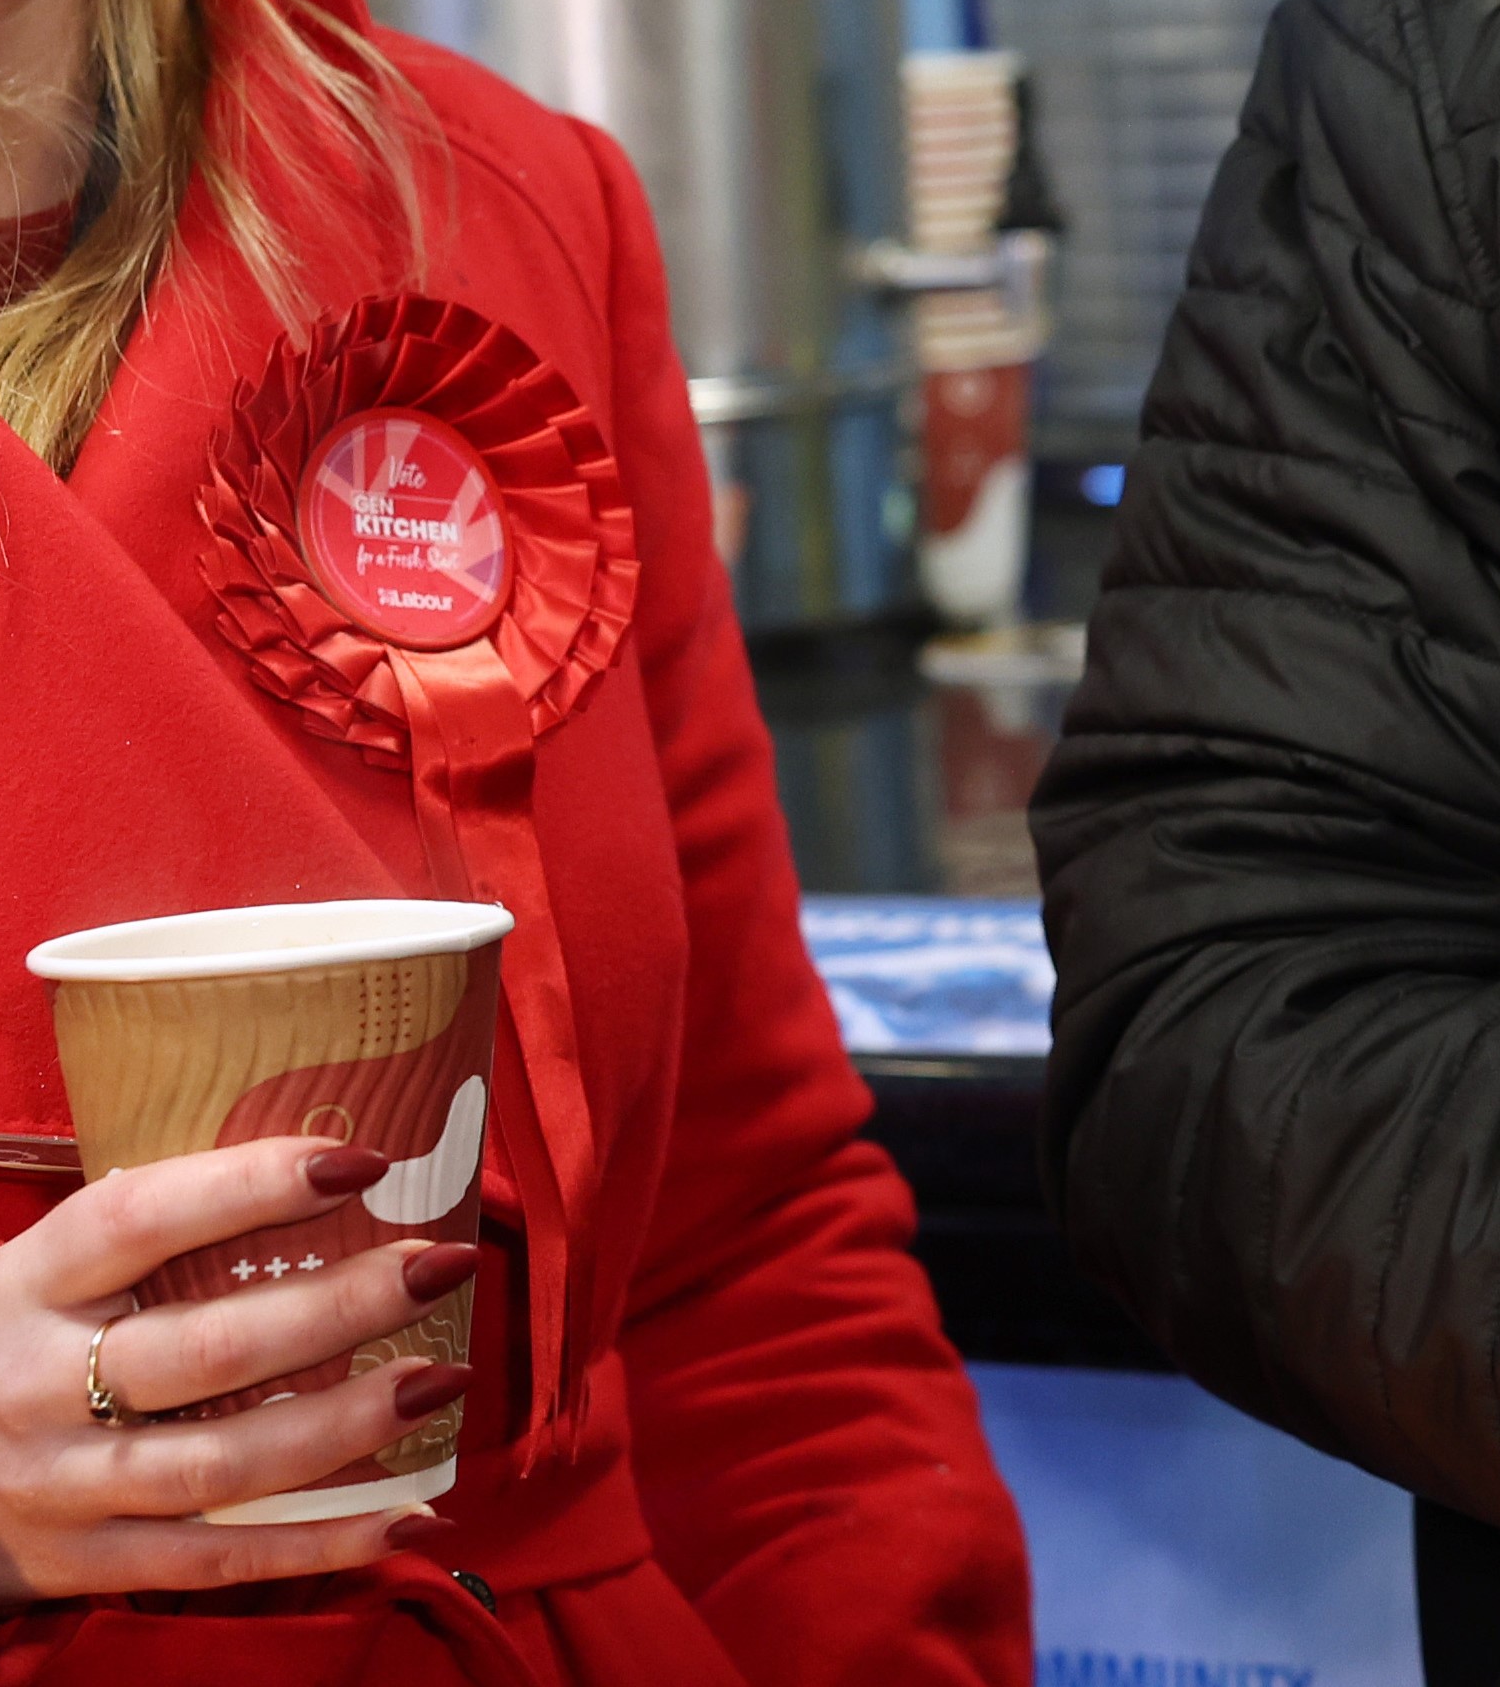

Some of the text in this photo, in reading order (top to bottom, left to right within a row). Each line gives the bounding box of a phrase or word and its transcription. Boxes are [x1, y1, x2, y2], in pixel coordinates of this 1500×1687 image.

[388, 454, 427, 489] Vote
[354, 493, 395, 515] GEN
[355, 513, 460, 542] KITCHEN
[356, 543, 373, 576] for
[394, 588, 454, 611] Labour
[1034, 1645, 1315, 1687] MMUNITY
